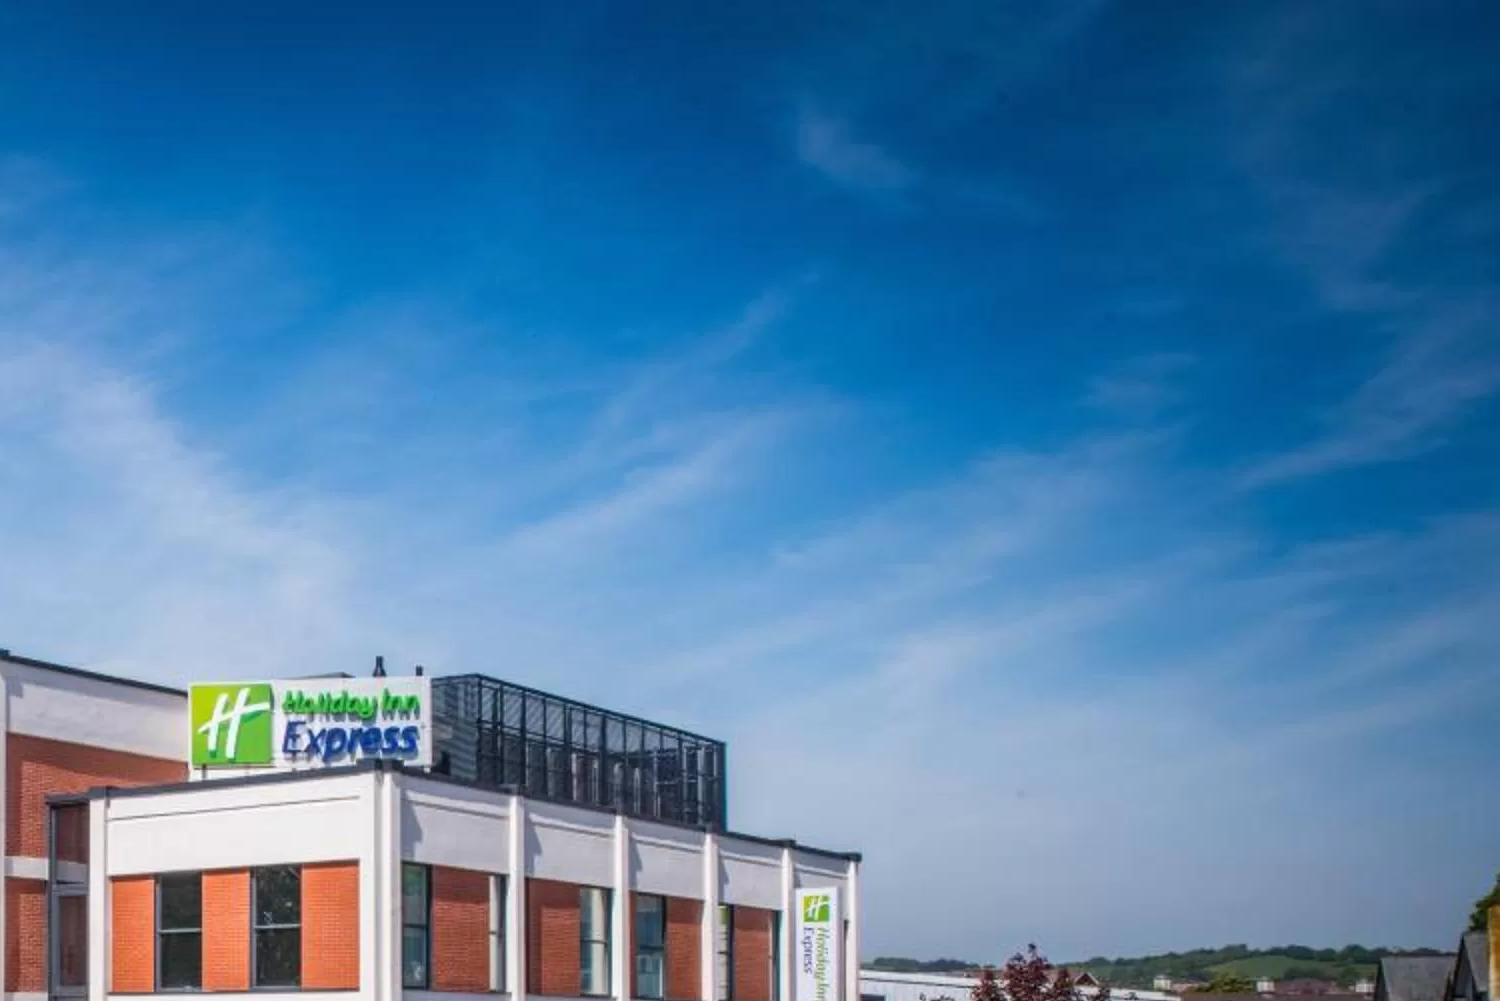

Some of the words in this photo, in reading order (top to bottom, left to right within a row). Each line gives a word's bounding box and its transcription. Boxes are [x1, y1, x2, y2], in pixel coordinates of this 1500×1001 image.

[282, 689, 377, 719] Holiday
[382, 688, 420, 717] Inn
[282, 720, 419, 763] Express
